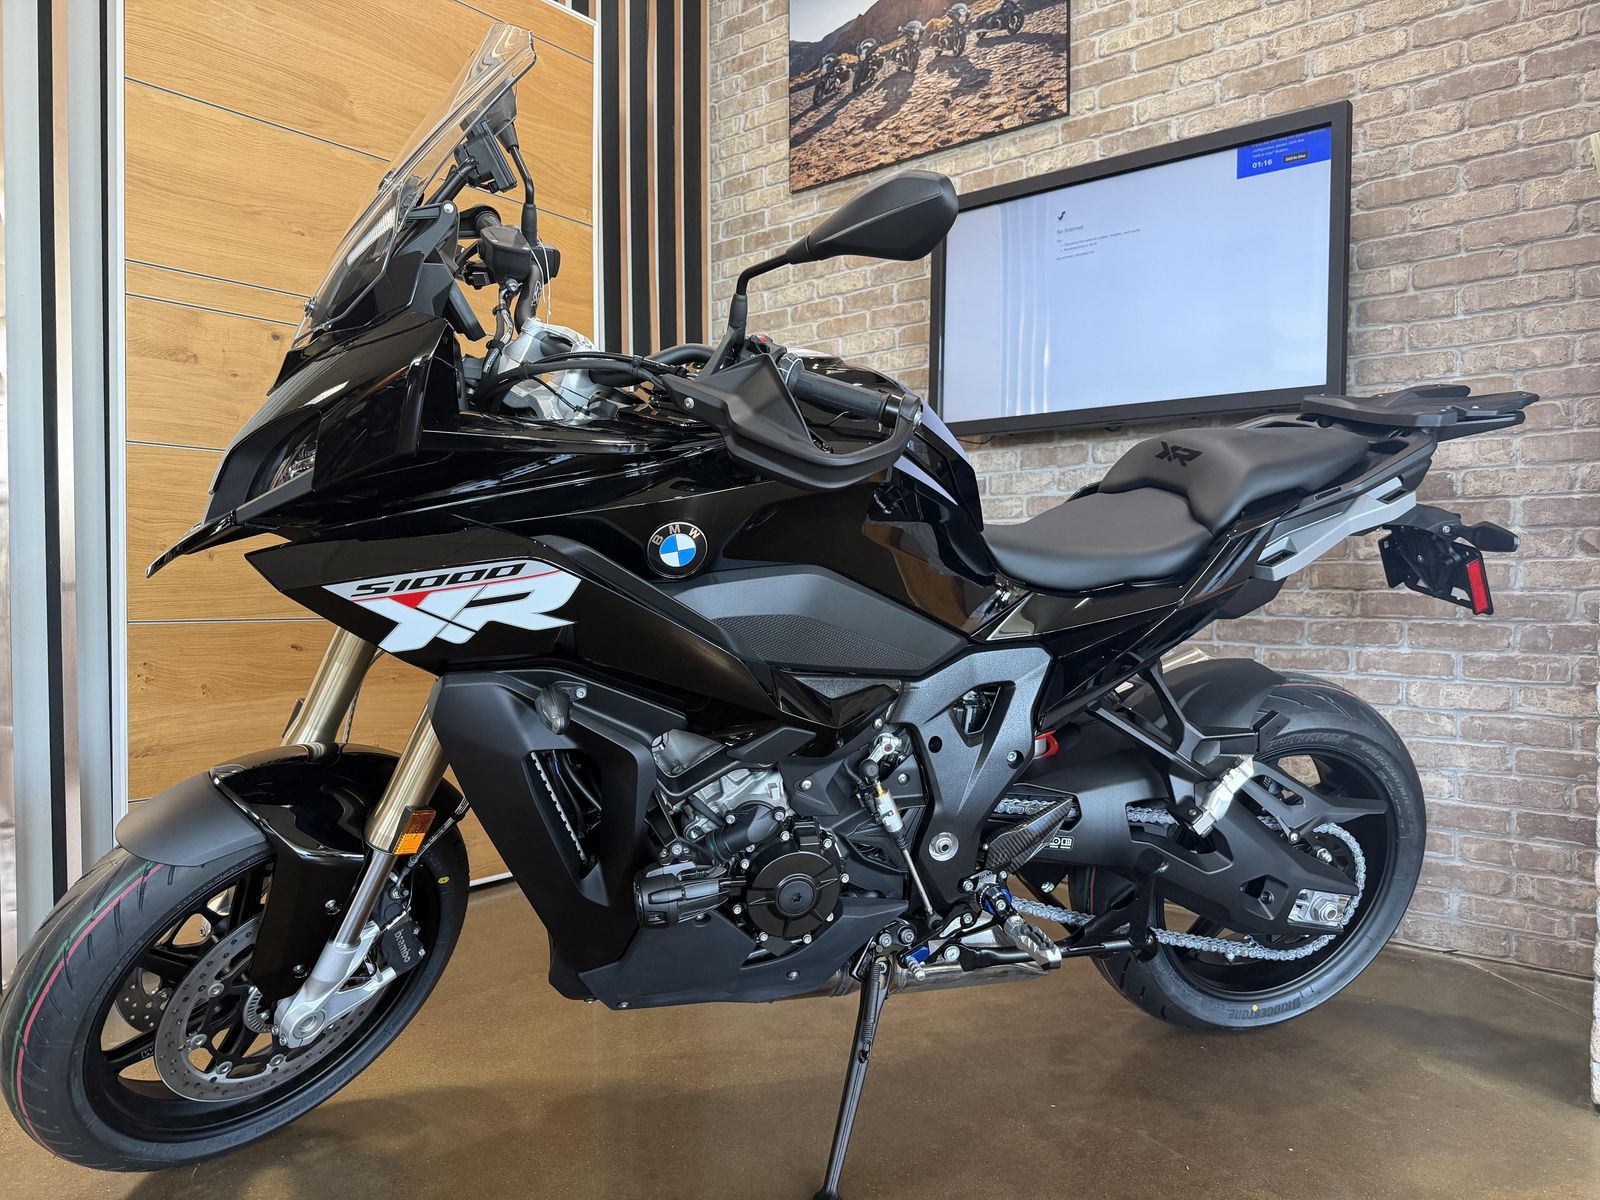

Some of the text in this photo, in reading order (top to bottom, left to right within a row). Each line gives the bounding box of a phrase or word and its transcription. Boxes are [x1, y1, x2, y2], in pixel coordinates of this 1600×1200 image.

[1252, 159, 1272, 169] 01:16
[1155, 441, 1203, 467] XR
[651, 524, 701, 546] BMW
[352, 570, 582, 653] XR
[393, 928, 411, 963] brembo
